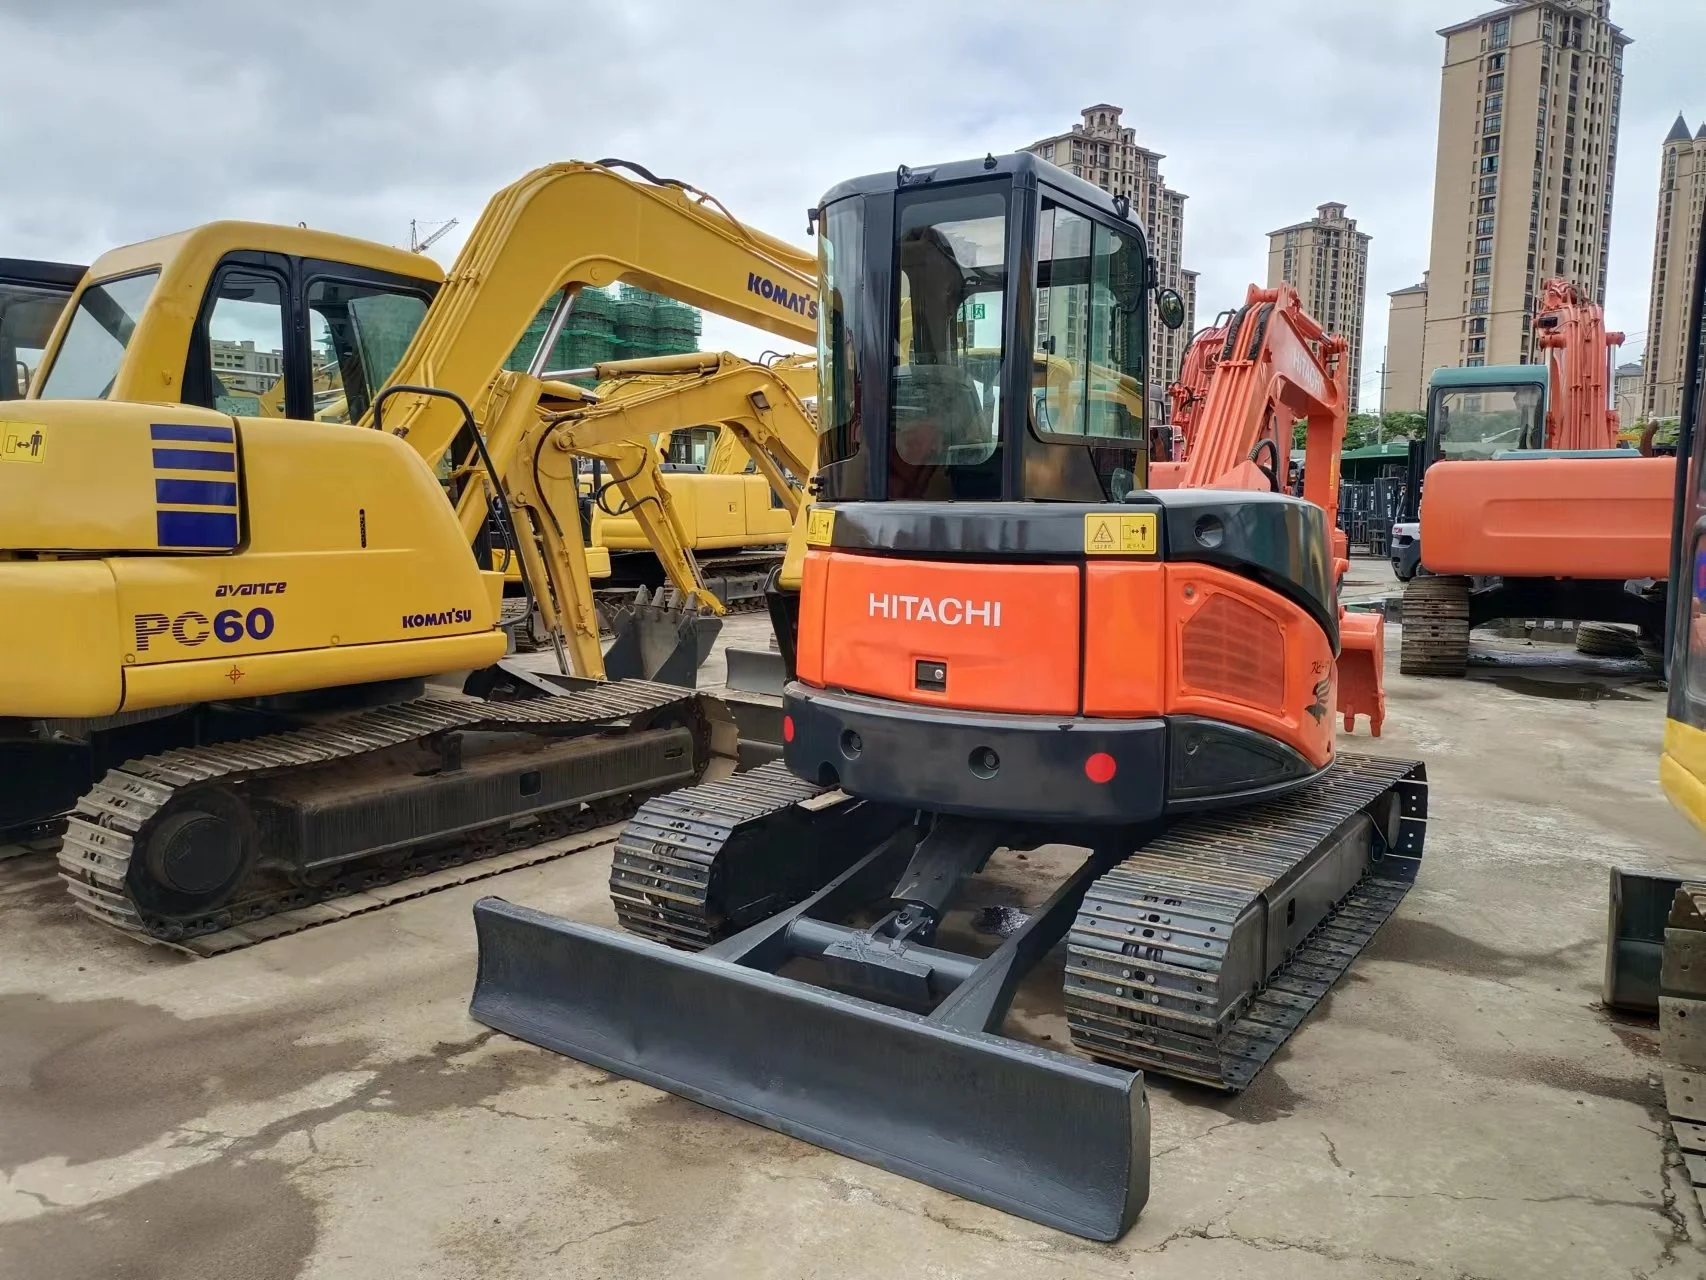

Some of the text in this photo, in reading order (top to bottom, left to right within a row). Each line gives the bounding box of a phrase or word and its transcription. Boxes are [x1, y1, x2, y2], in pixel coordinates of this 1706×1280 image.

[215, 581, 287, 597] avance
[402, 608, 472, 628] KOMATSU
[868, 592, 1001, 627] HITACHI
[135, 607, 274, 651] PC60
